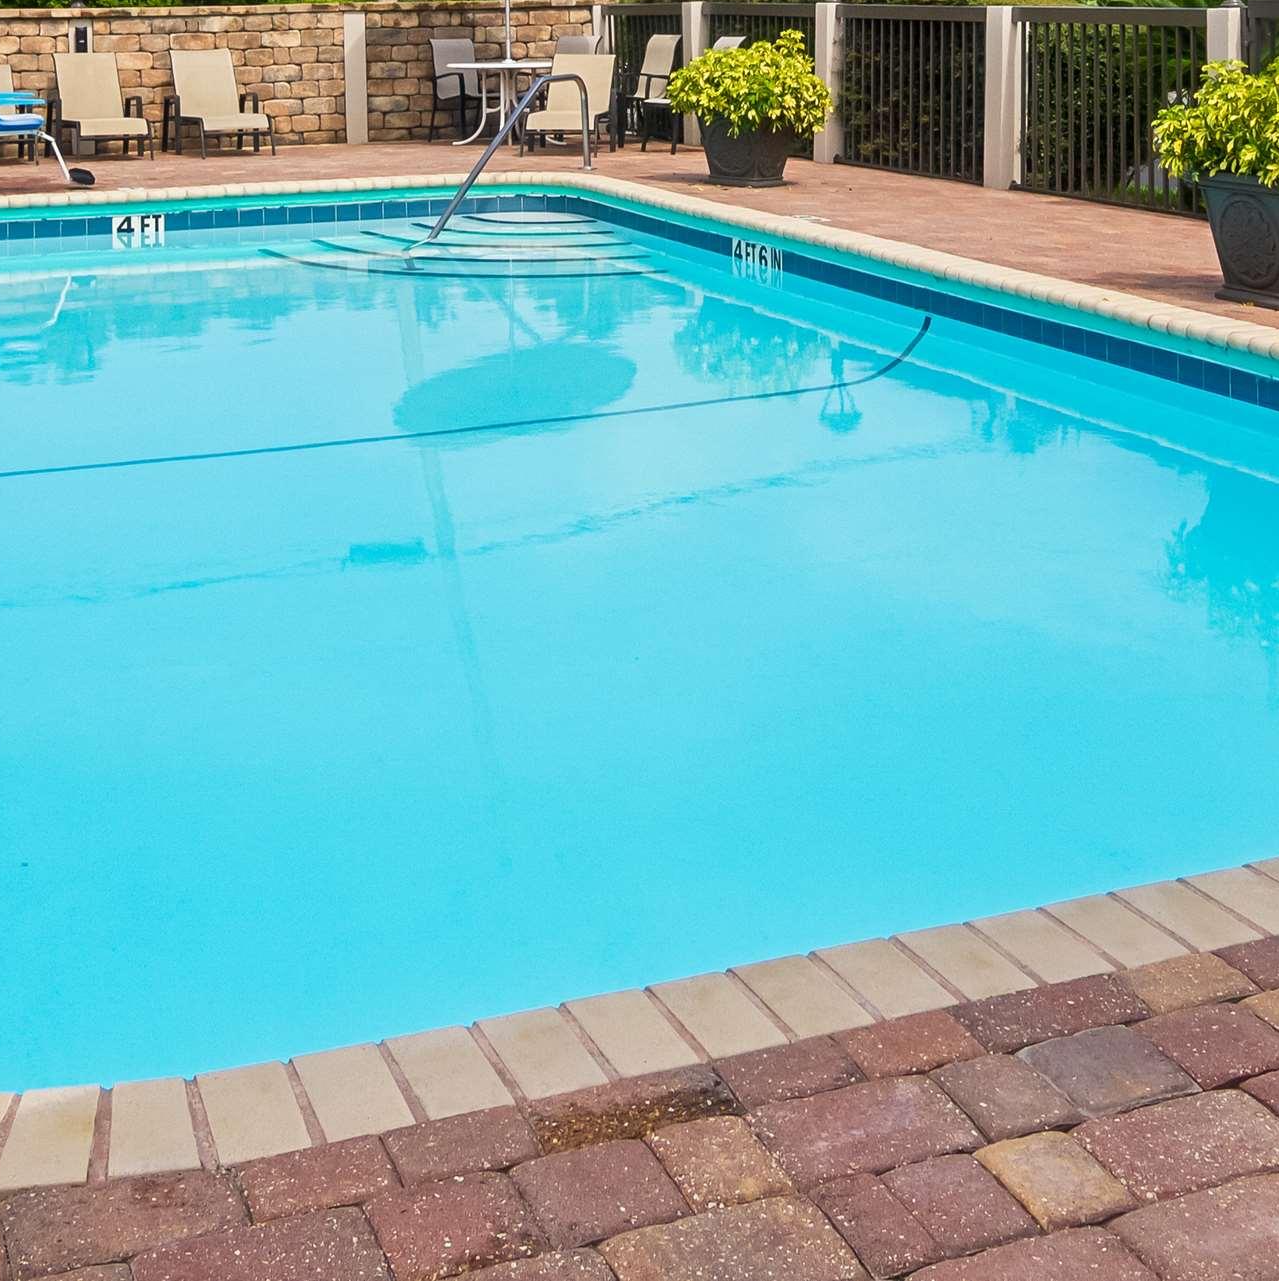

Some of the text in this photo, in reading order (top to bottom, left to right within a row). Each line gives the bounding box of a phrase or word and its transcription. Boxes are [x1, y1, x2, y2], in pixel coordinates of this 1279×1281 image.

[116, 214, 162, 234] 4 FT
[733, 239, 782, 271] 4 FT 6 IN
